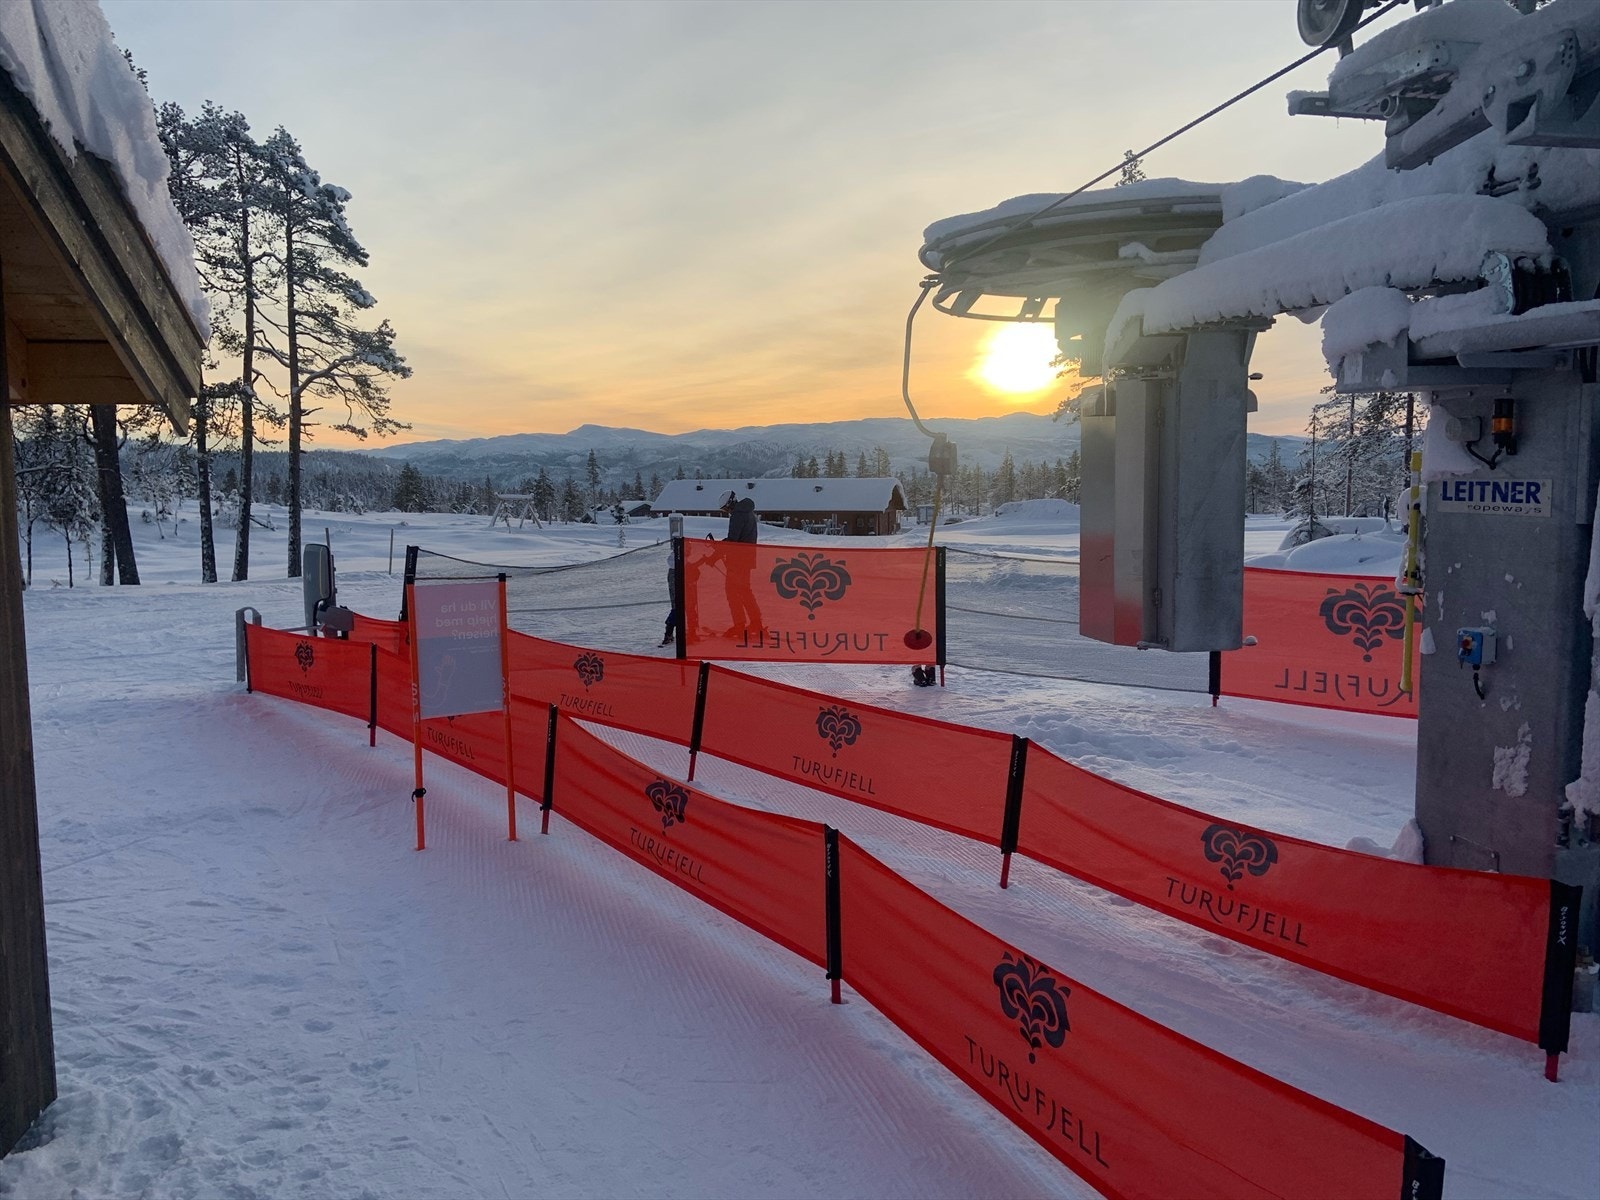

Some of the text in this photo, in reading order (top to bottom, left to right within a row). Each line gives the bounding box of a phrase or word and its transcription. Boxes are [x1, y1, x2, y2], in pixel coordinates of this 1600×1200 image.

[1442, 480, 1541, 504] LEITNER
[560, 693, 615, 718] TURUFJELL
[427, 726, 475, 760] TURUFJELL
[792, 755, 876, 795] TURUFJELL
[629, 827, 706, 885] TURUFJELL
[1166, 876, 1308, 947] TURUFJELL
[964, 1034, 1110, 1169] TURUFJELL
